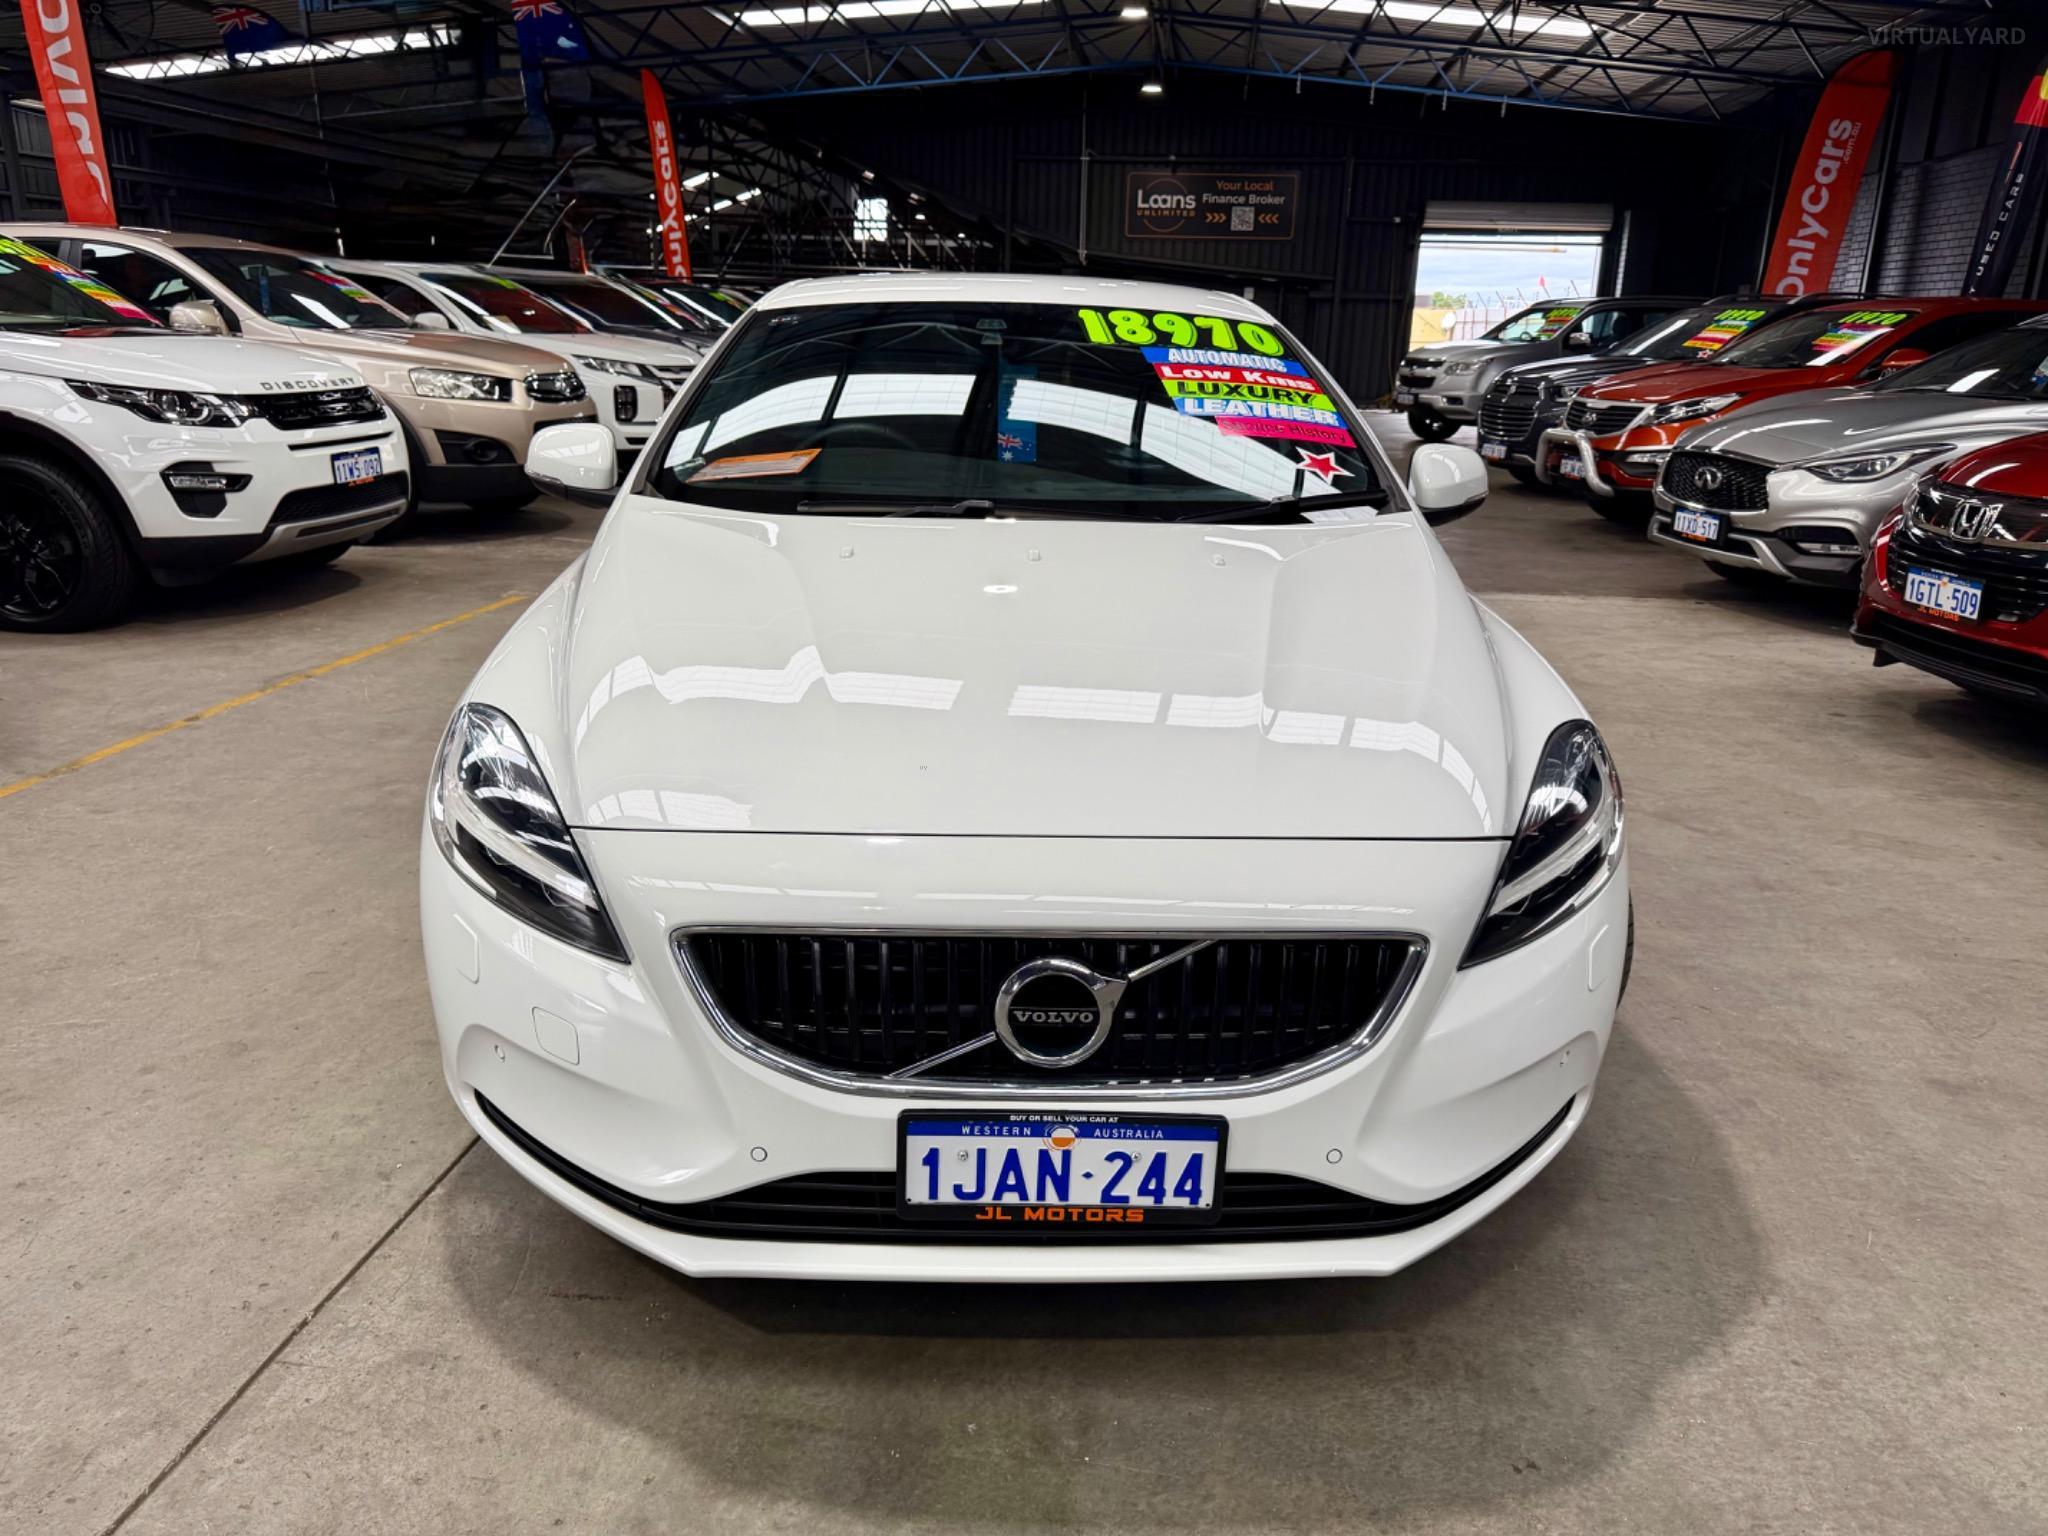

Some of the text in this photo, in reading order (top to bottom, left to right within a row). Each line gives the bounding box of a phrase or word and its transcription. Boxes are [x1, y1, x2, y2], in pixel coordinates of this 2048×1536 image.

[1216, 181, 1274, 191] Your Local
[1137, 189, 1196, 209] Loans
[1202, 193, 1285, 205] Finance Broker
[1136, 209, 1196, 217] UNLIMITED
[1975, 230, 2000, 277] USED
[1078, 309, 1284, 357] 18970
[1167, 349, 1288, 373] AUTOMATIC
[1160, 365, 1232, 381] Low
[260, 377, 356, 391] DISCOVERY
[1177, 381, 1314, 404] LUXURY
[1184, 398, 1340, 427] LEATHER
[1289, 424, 1346, 444] History
[1013, 1010, 1094, 1023] VOLVO
[1009, 1114, 1027, 1122] BUY
[961, 1125, 1164, 1139] WESTERN AUSTRALIA
[975, 1206, 1145, 1222] JL MOTORS
